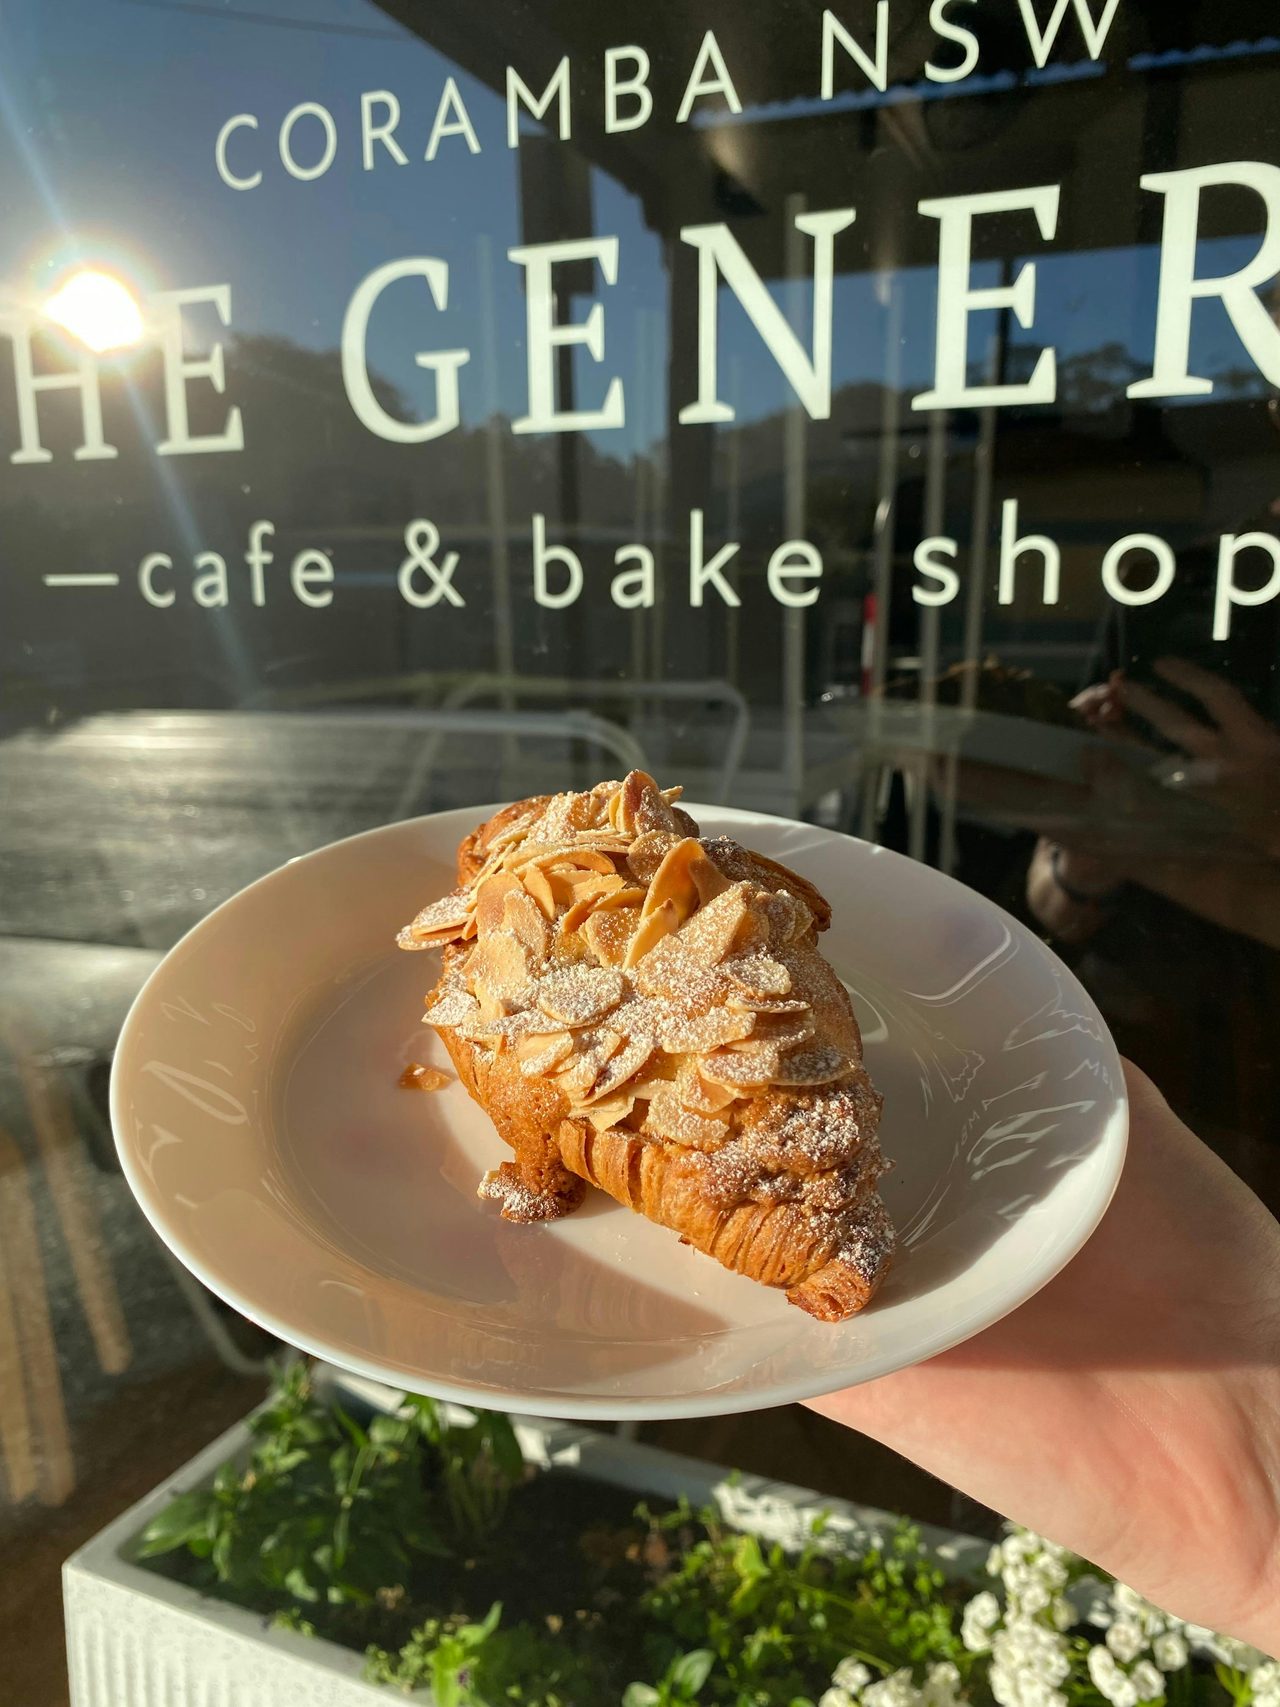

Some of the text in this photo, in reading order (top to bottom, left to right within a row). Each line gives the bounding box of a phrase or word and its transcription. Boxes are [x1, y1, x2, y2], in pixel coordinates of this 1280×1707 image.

[215, 0, 1121, 191] CORAMBA NSW
[340, 161, 1280, 443] GENER
[140, 498, 1280, 641] cafe & bake shop
